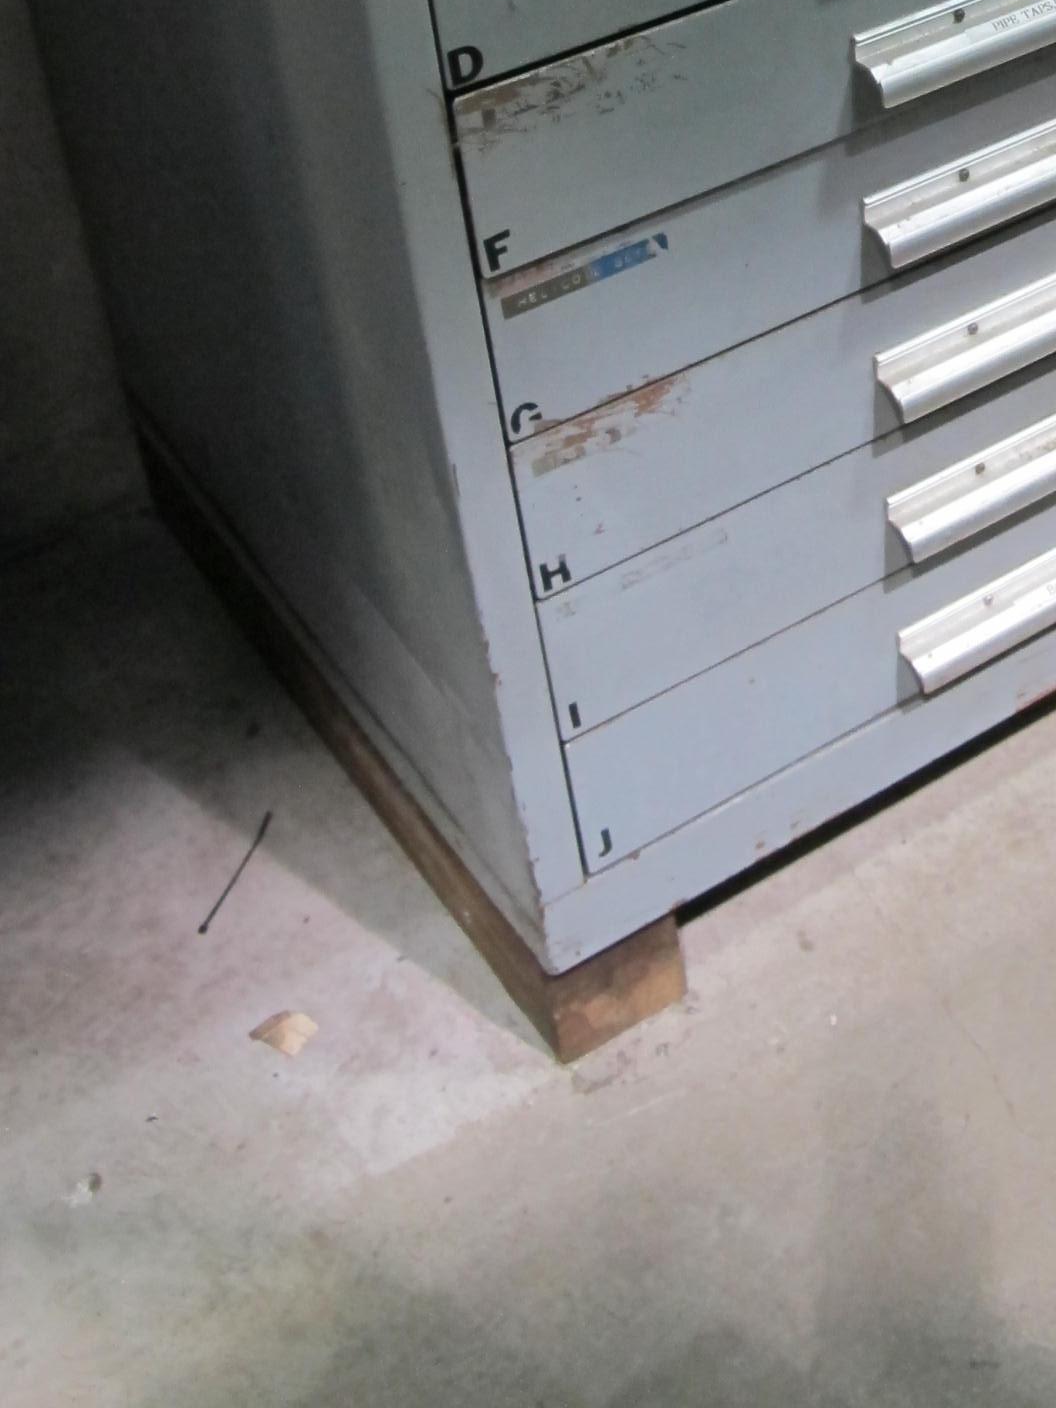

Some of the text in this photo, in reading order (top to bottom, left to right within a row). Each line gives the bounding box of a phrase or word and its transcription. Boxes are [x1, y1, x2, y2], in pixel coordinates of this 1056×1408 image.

[992, 14, 1022, 32] PIPE
[447, 45, 484, 86] D
[483, 229, 511, 273] F
[539, 553, 572, 592] H
[568, 701, 582, 729] I
[598, 827, 613, 858] J
